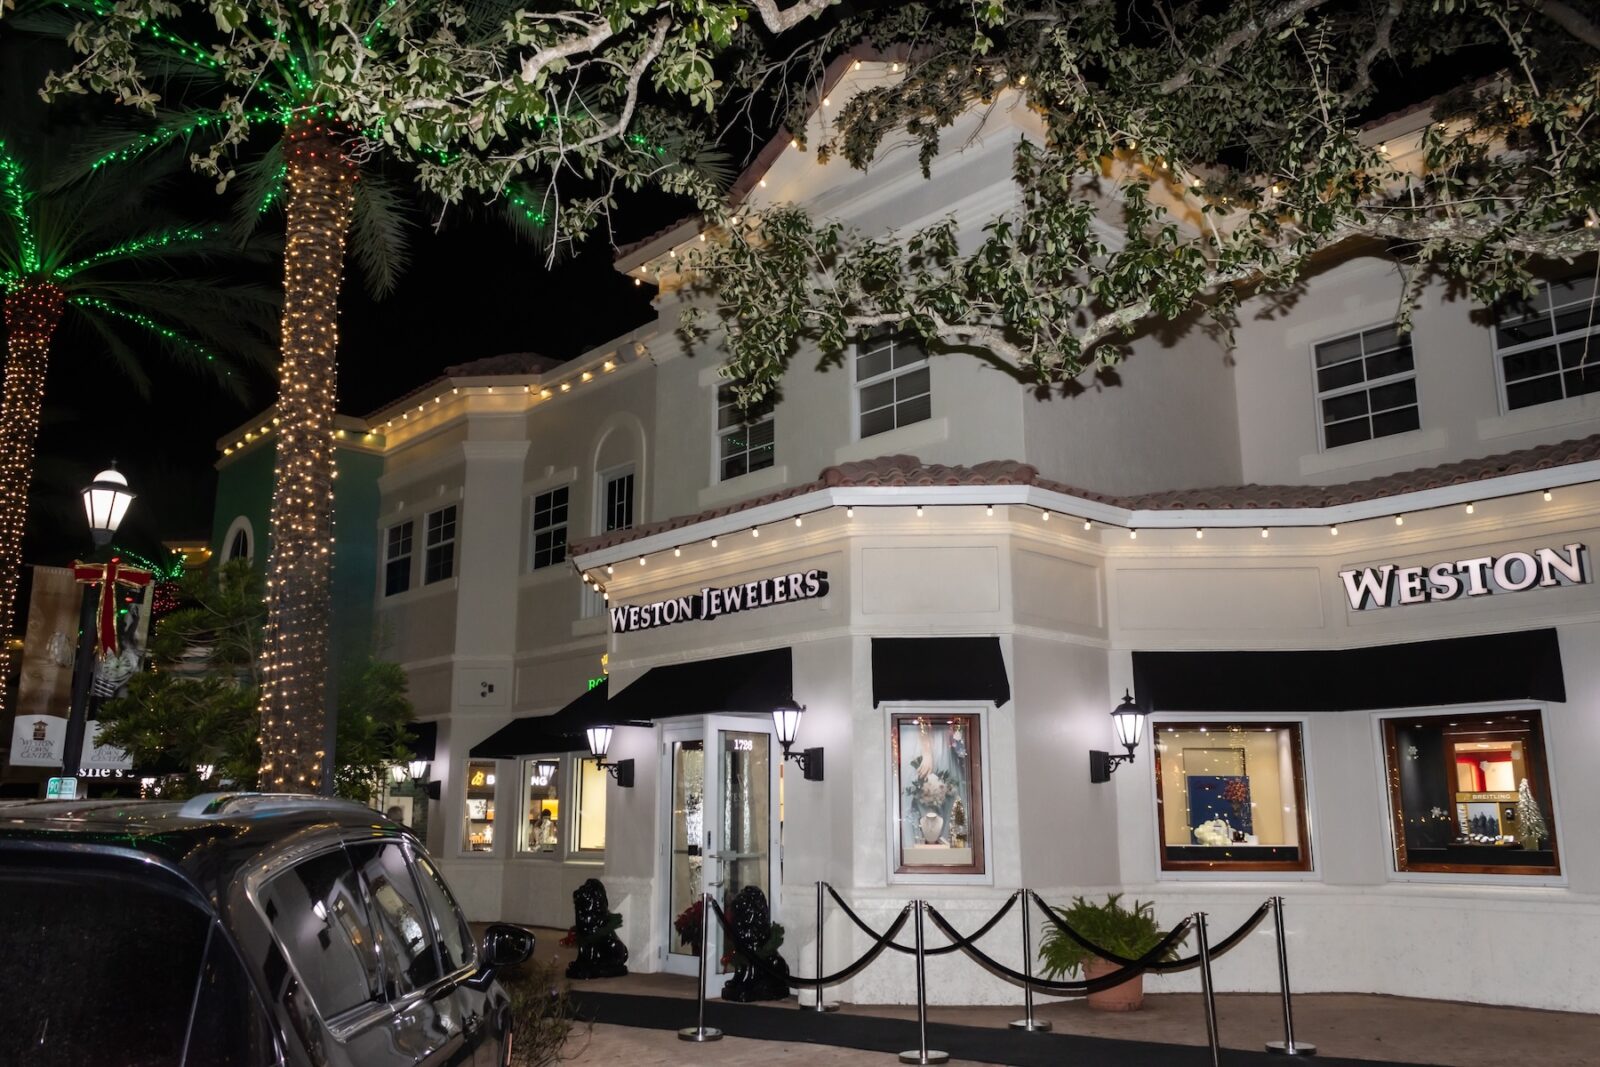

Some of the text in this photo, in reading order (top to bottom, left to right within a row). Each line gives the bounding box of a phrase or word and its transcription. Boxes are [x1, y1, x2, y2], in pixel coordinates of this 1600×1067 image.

[610, 569, 828, 633] WESTON JEWELERS
[1339, 543, 1585, 610] WESTON
